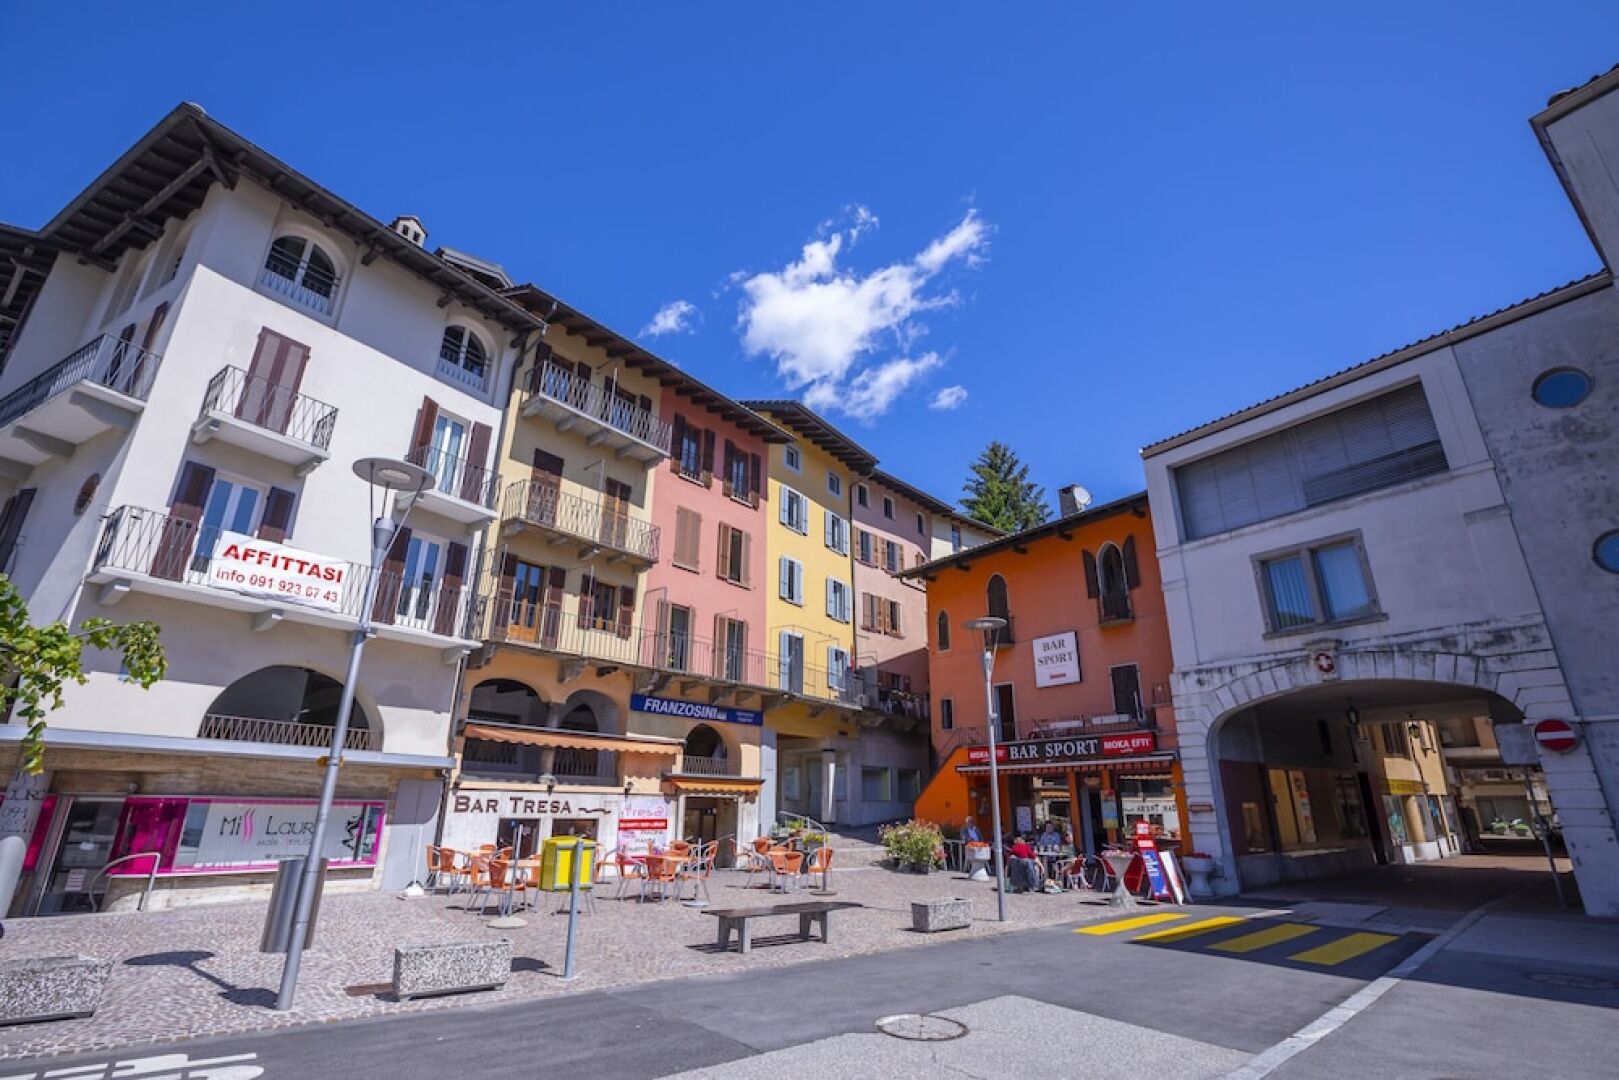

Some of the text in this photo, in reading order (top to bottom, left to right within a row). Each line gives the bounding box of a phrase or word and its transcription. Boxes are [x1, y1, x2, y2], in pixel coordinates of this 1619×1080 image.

[223, 543, 343, 583] AFFITTASI
[249, 574, 273, 589] 091
[279, 580, 302, 595] 923
[323, 590, 338, 603] 43
[1041, 639, 1066, 652] BAR
[1037, 651, 1074, 666] SPORT
[643, 698, 718, 719] FRANZOSINI
[1009, 739, 1099, 761] BAR SPORT
